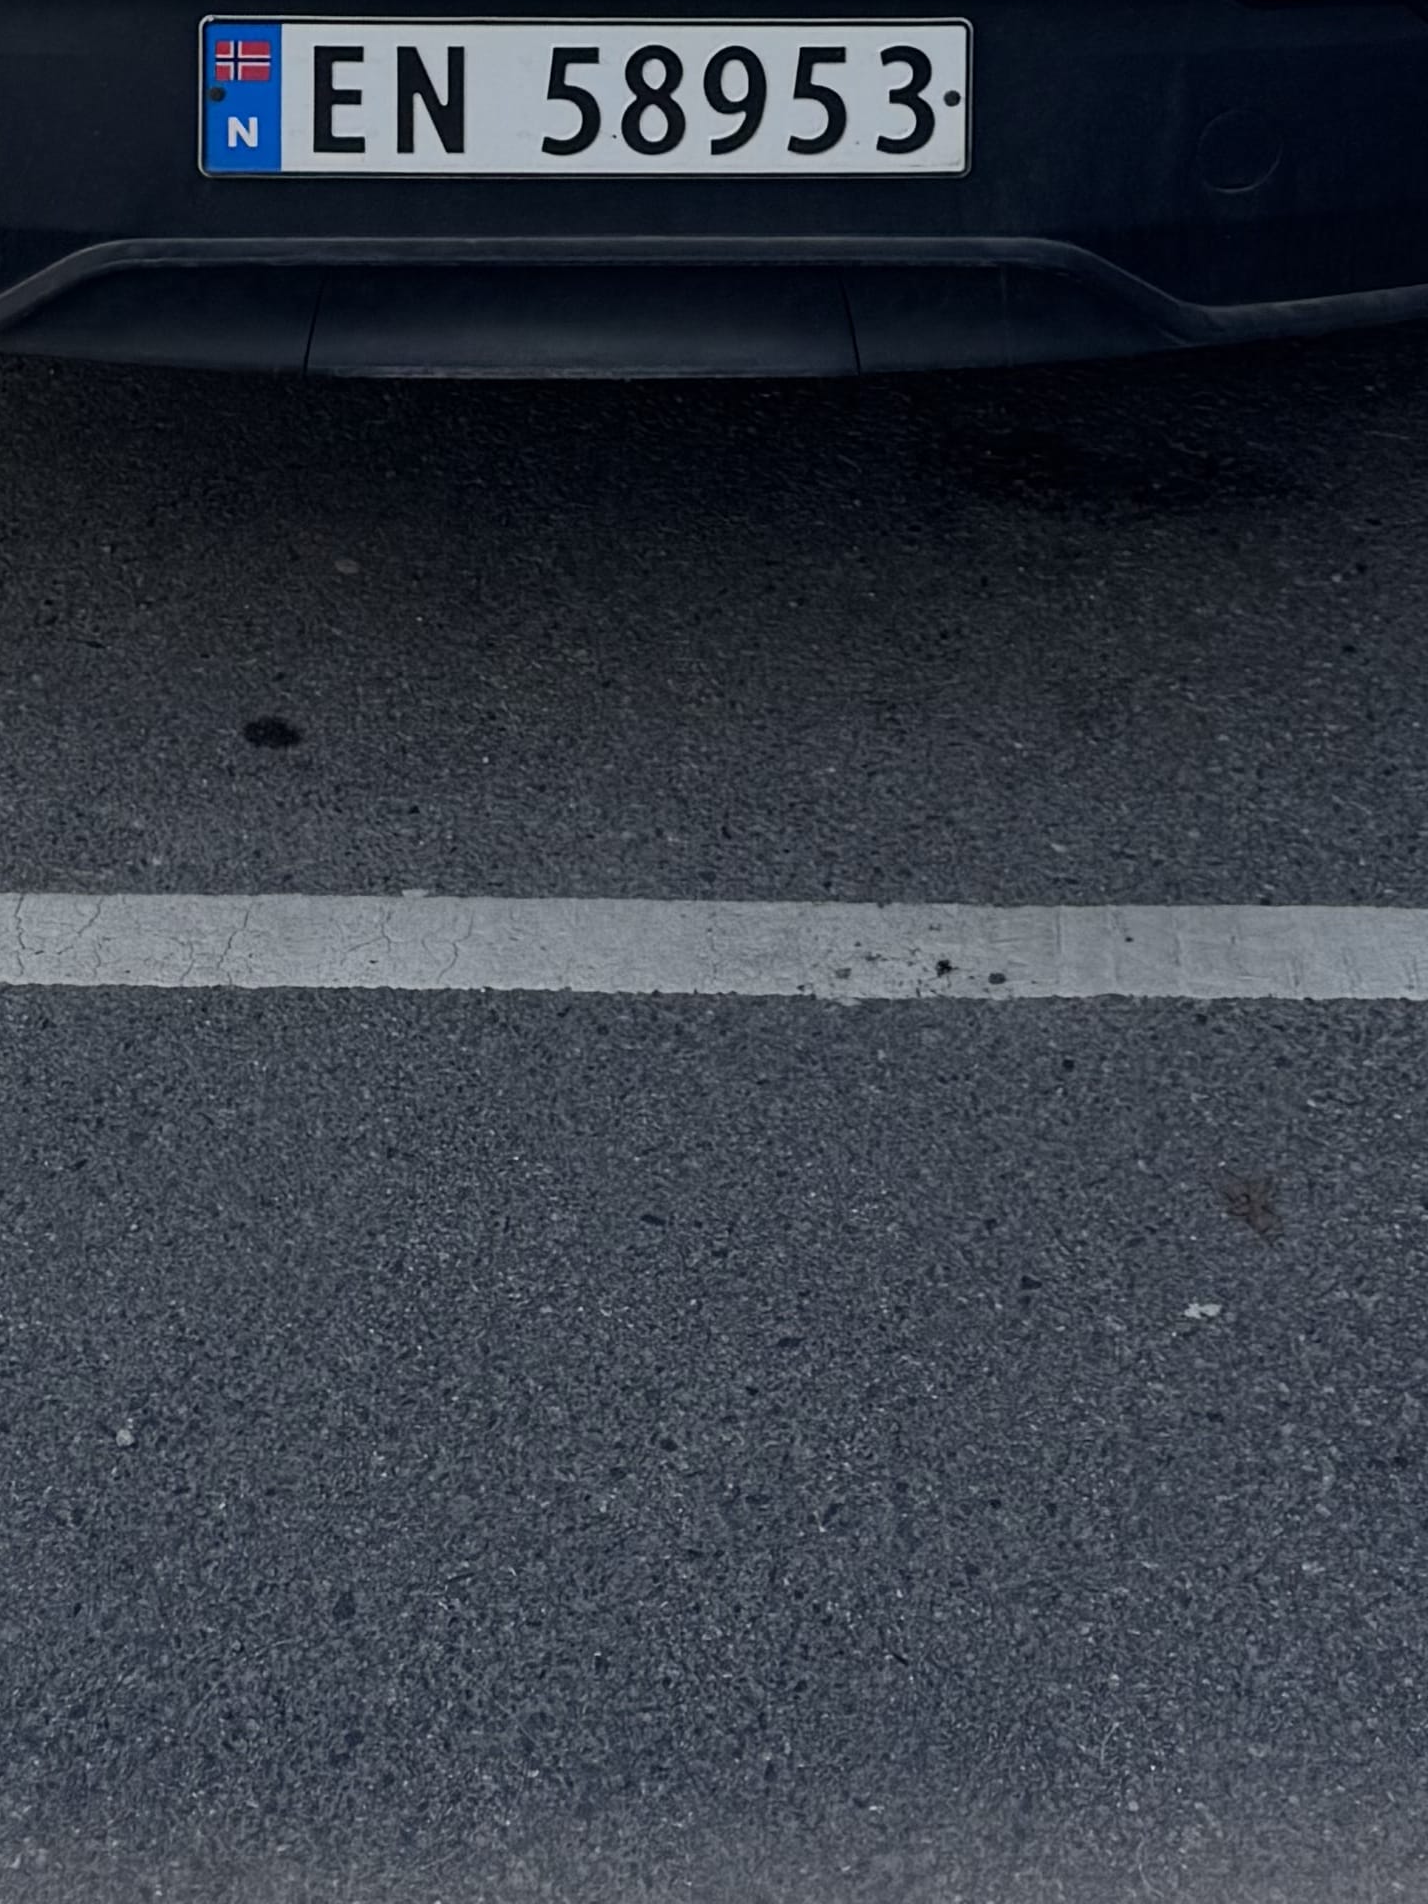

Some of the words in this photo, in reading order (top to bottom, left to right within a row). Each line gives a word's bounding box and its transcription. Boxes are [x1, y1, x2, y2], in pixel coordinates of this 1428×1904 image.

[227, 116, 258, 147] N
[313, 45, 465, 154] EN
[541, 44, 935, 156] 58953
